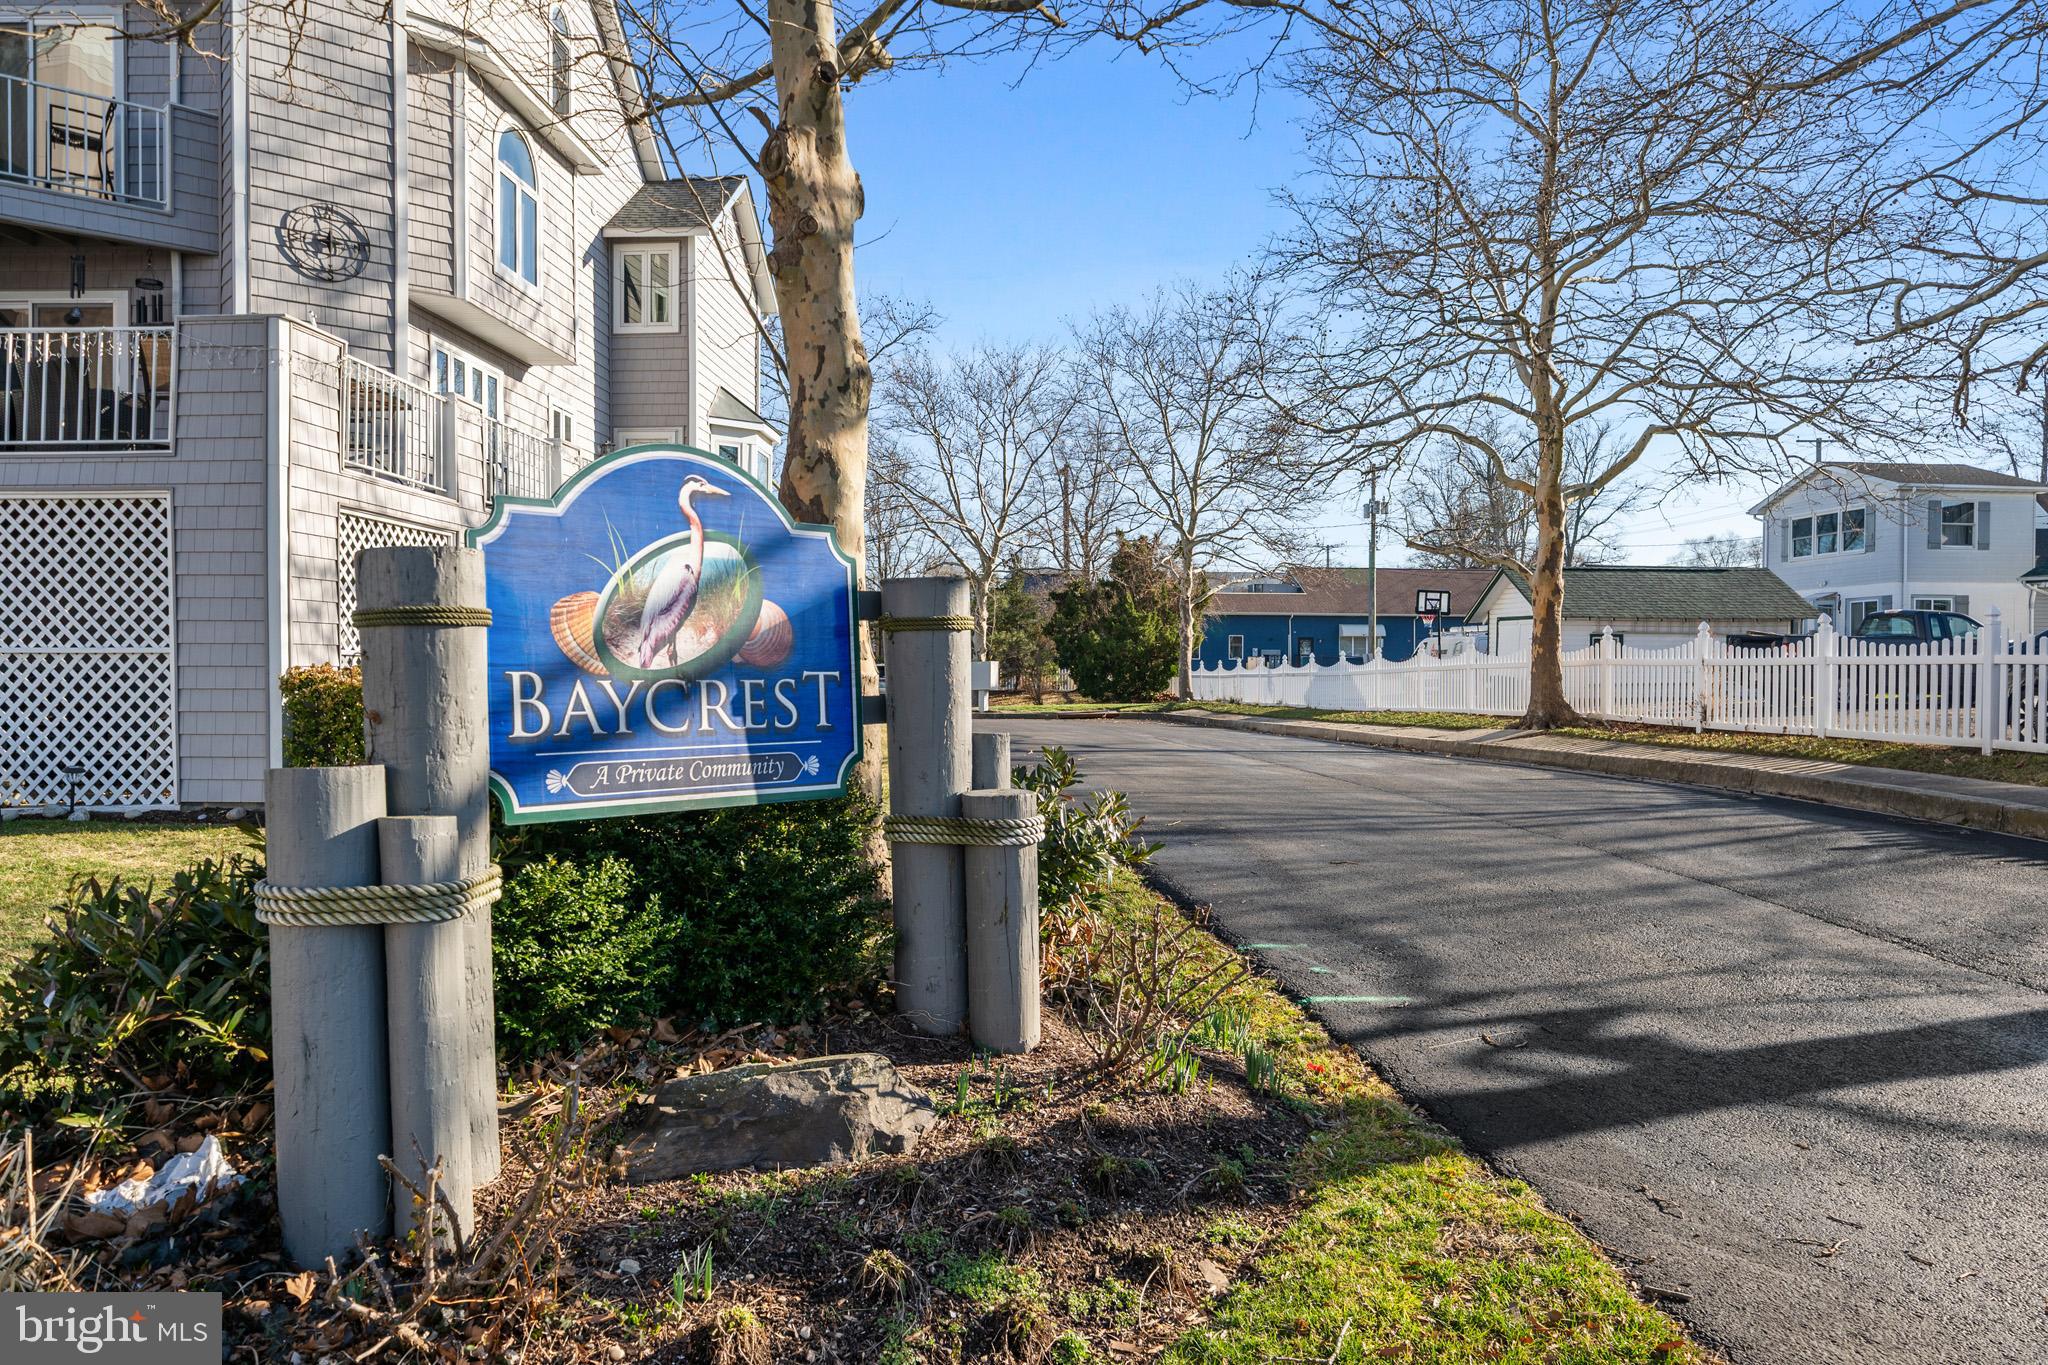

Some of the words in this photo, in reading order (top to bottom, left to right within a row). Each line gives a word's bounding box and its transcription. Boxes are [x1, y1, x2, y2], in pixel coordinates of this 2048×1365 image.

[505, 670, 840, 738] BAYCREST
[590, 765, 610, 789] A
[615, 764, 683, 785] Private
[689, 755, 785, 782] Community
